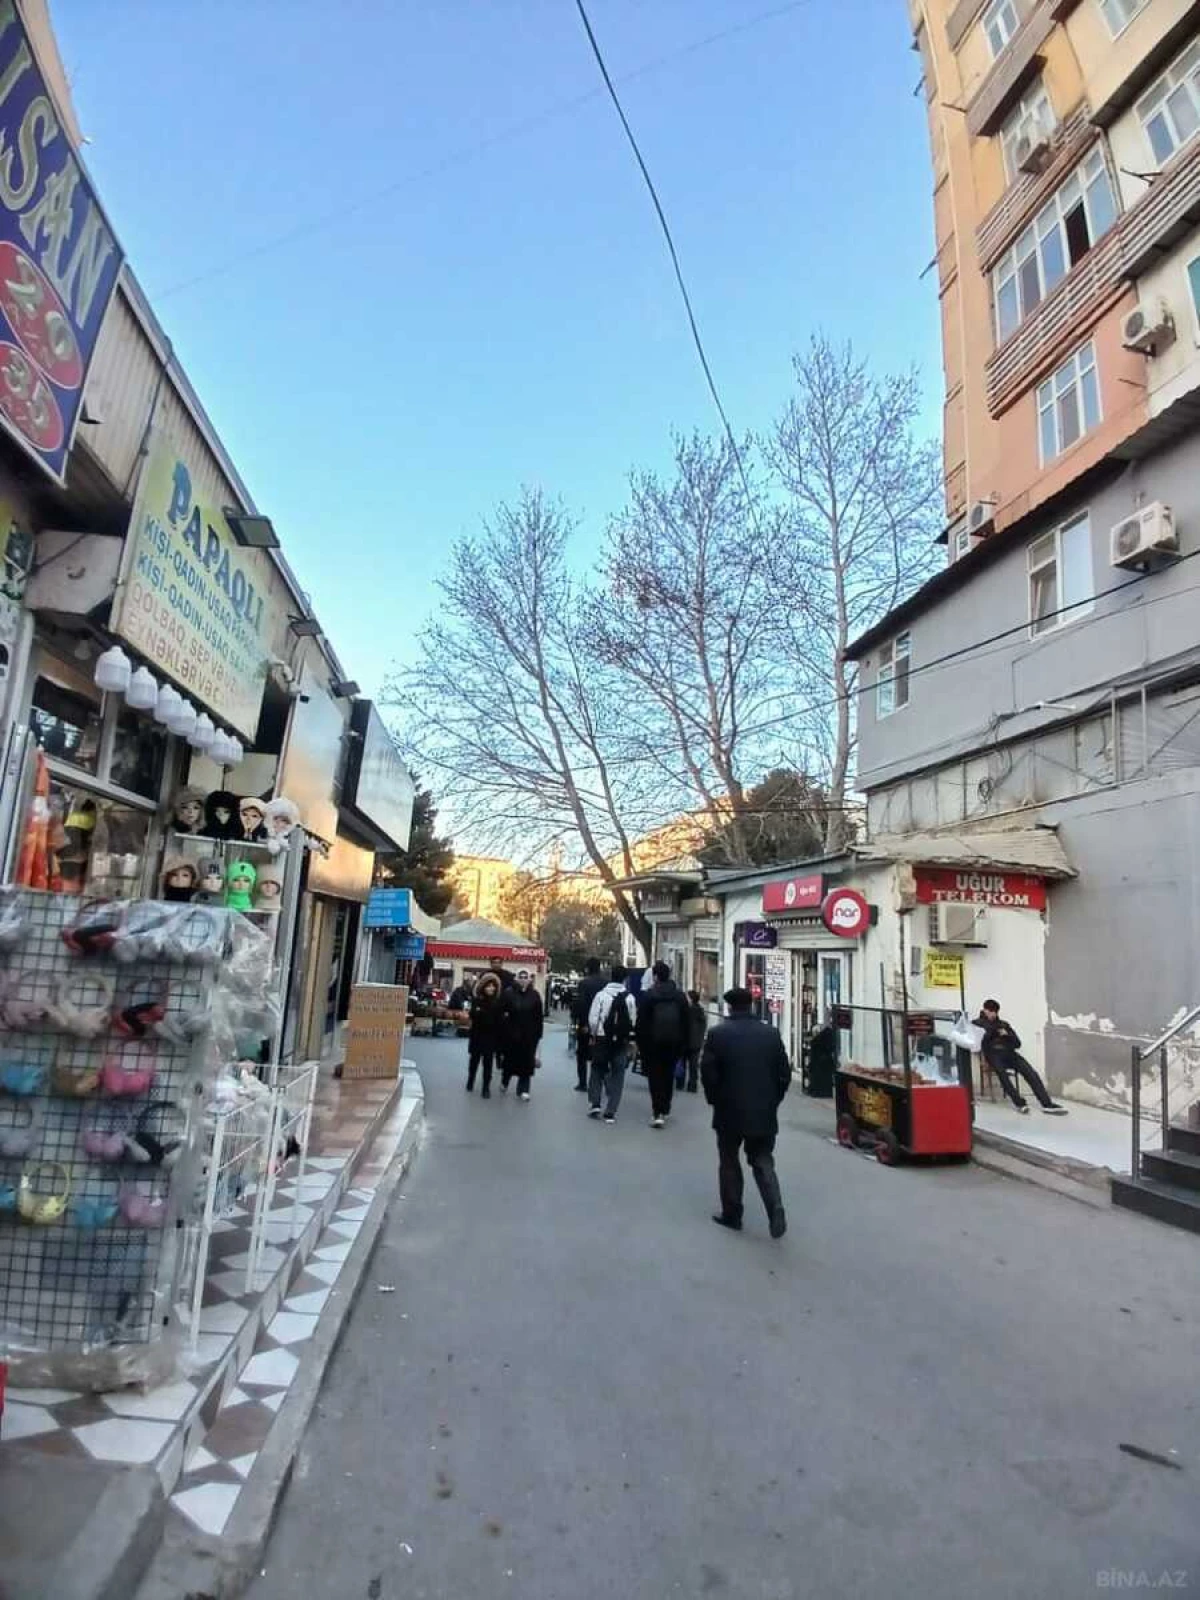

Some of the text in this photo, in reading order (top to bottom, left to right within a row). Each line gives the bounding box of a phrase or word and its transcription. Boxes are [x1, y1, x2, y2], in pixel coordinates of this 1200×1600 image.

[168, 459, 264, 636] PAPAQLI
[956, 872, 1005, 893] UĞUR
[932, 889, 1029, 906] TELEKOM
[835, 907, 859, 918] nar
